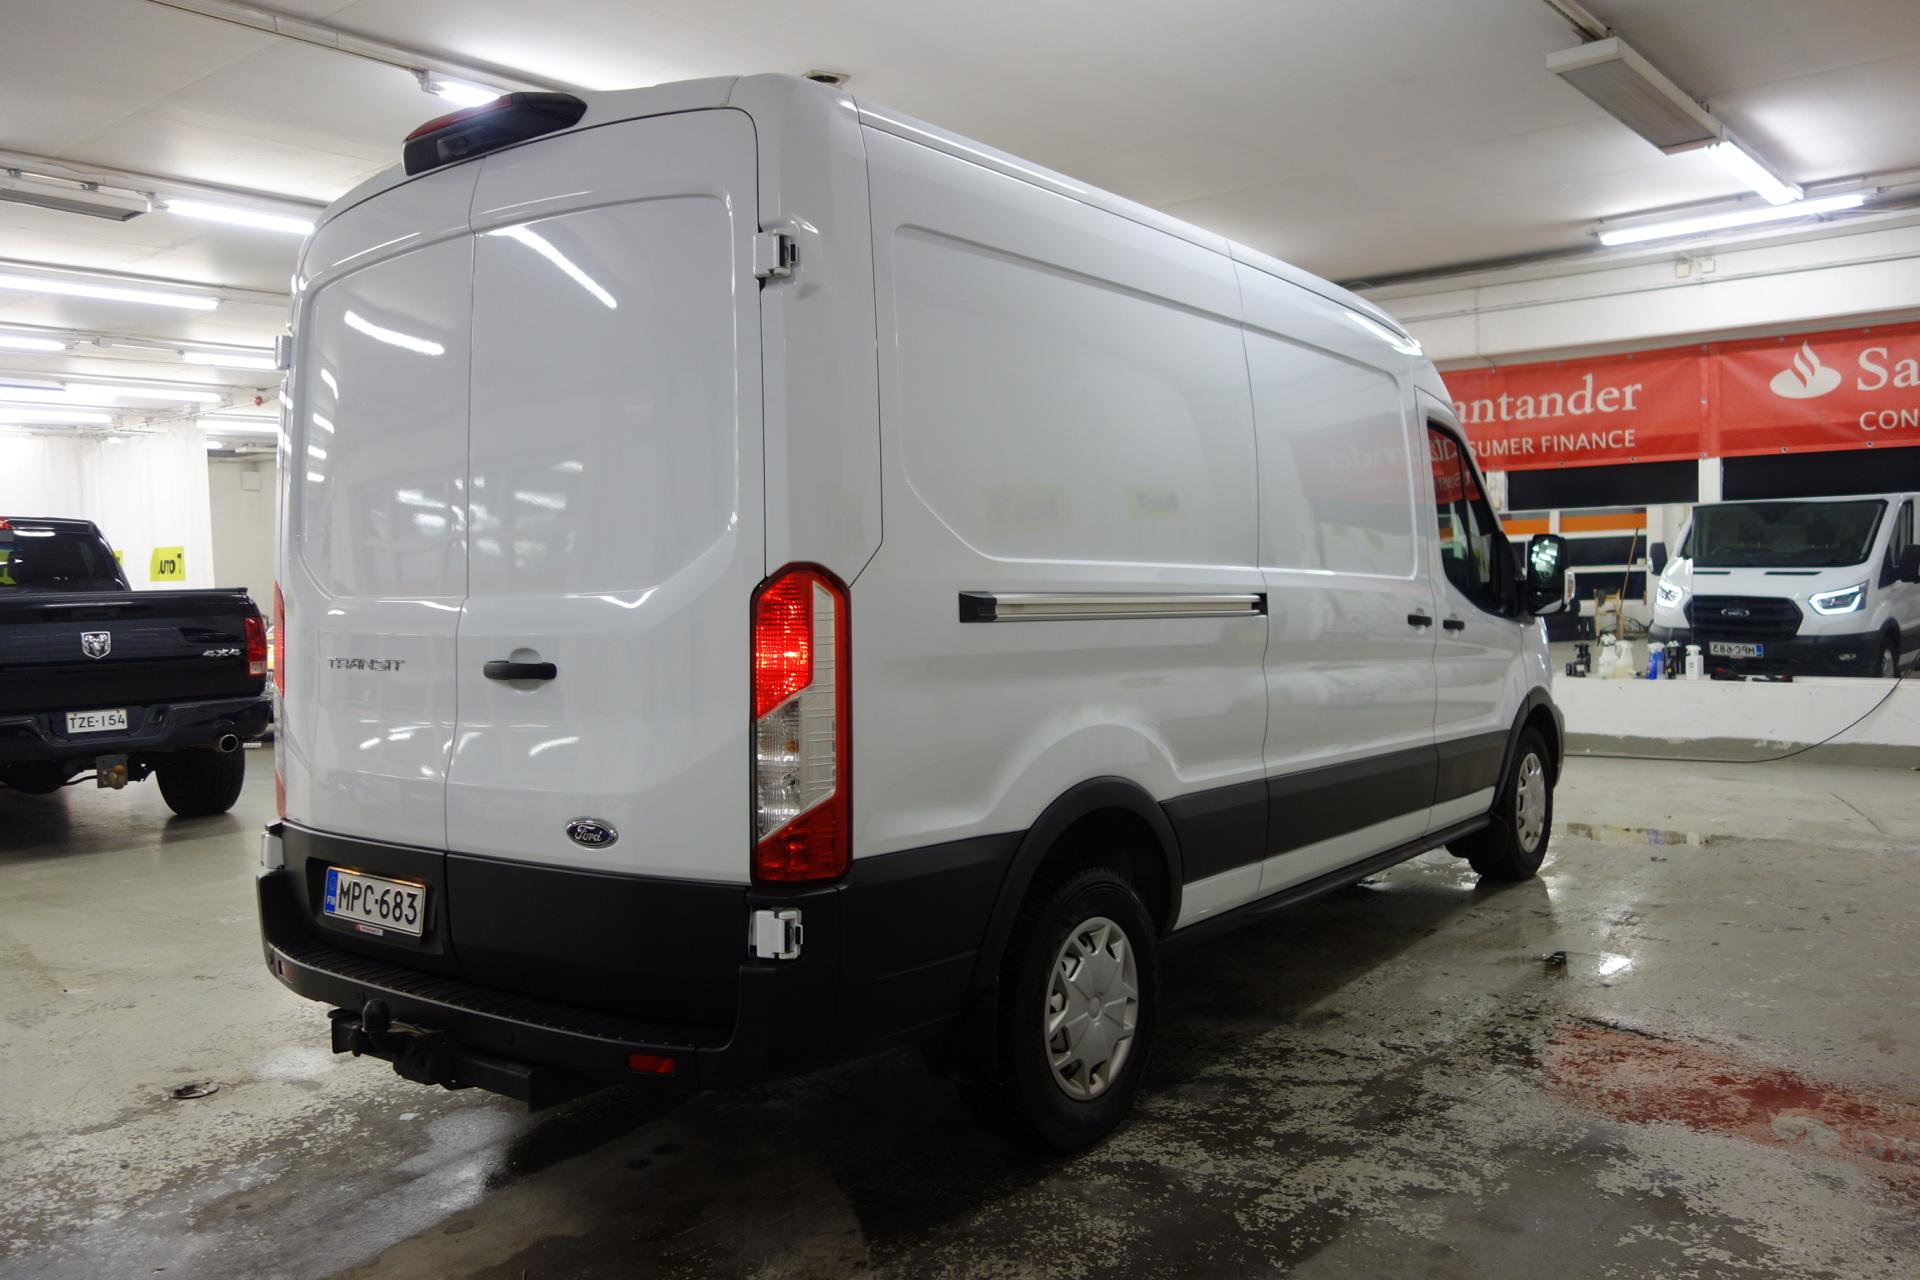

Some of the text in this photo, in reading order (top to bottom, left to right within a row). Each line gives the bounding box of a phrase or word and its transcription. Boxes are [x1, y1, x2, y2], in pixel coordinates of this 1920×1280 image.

[1860, 408, 1919, 431] CON
[1541, 429, 1636, 453] FINANCE
[328, 657, 405, 671] TRANSIT
[69, 714, 125, 729] TZE-154
[338, 880, 419, 925] MPC-683
